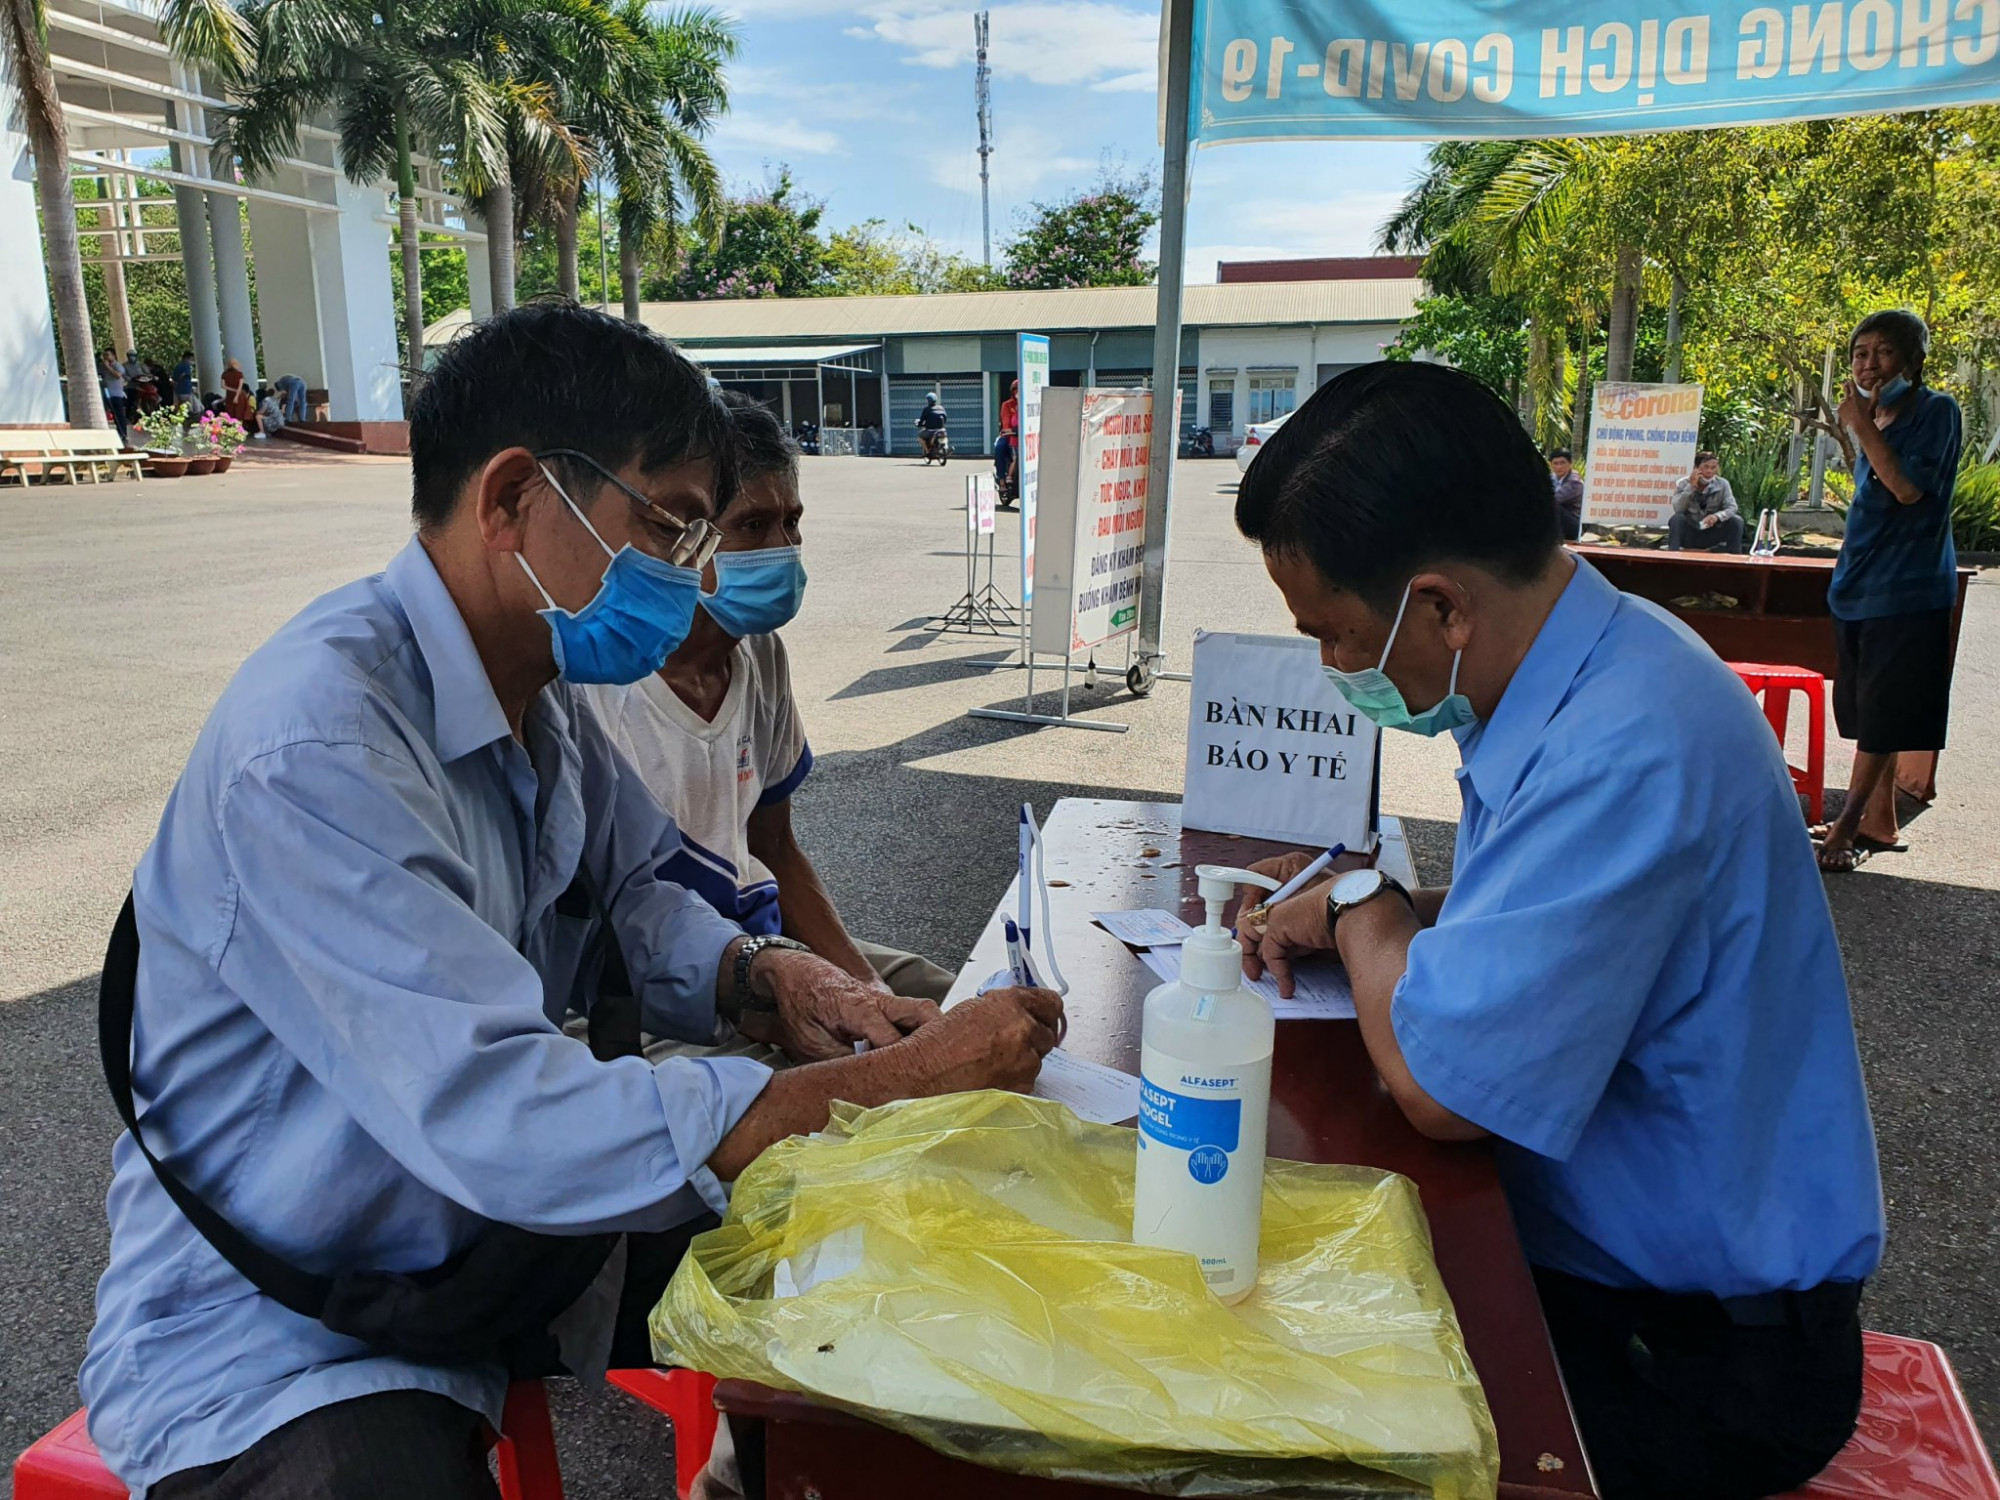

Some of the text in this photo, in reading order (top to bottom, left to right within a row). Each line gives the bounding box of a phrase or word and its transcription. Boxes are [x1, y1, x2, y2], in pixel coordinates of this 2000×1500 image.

[1619, 389, 1699, 420] corona
[1143, 409, 1153, 433] SỐ
[1204, 696, 1358, 736] BÀN KHAI
[1206, 740, 1348, 781] BÁO Y TẾ
[1180, 1075, 1236, 1088] ALFASEPT
